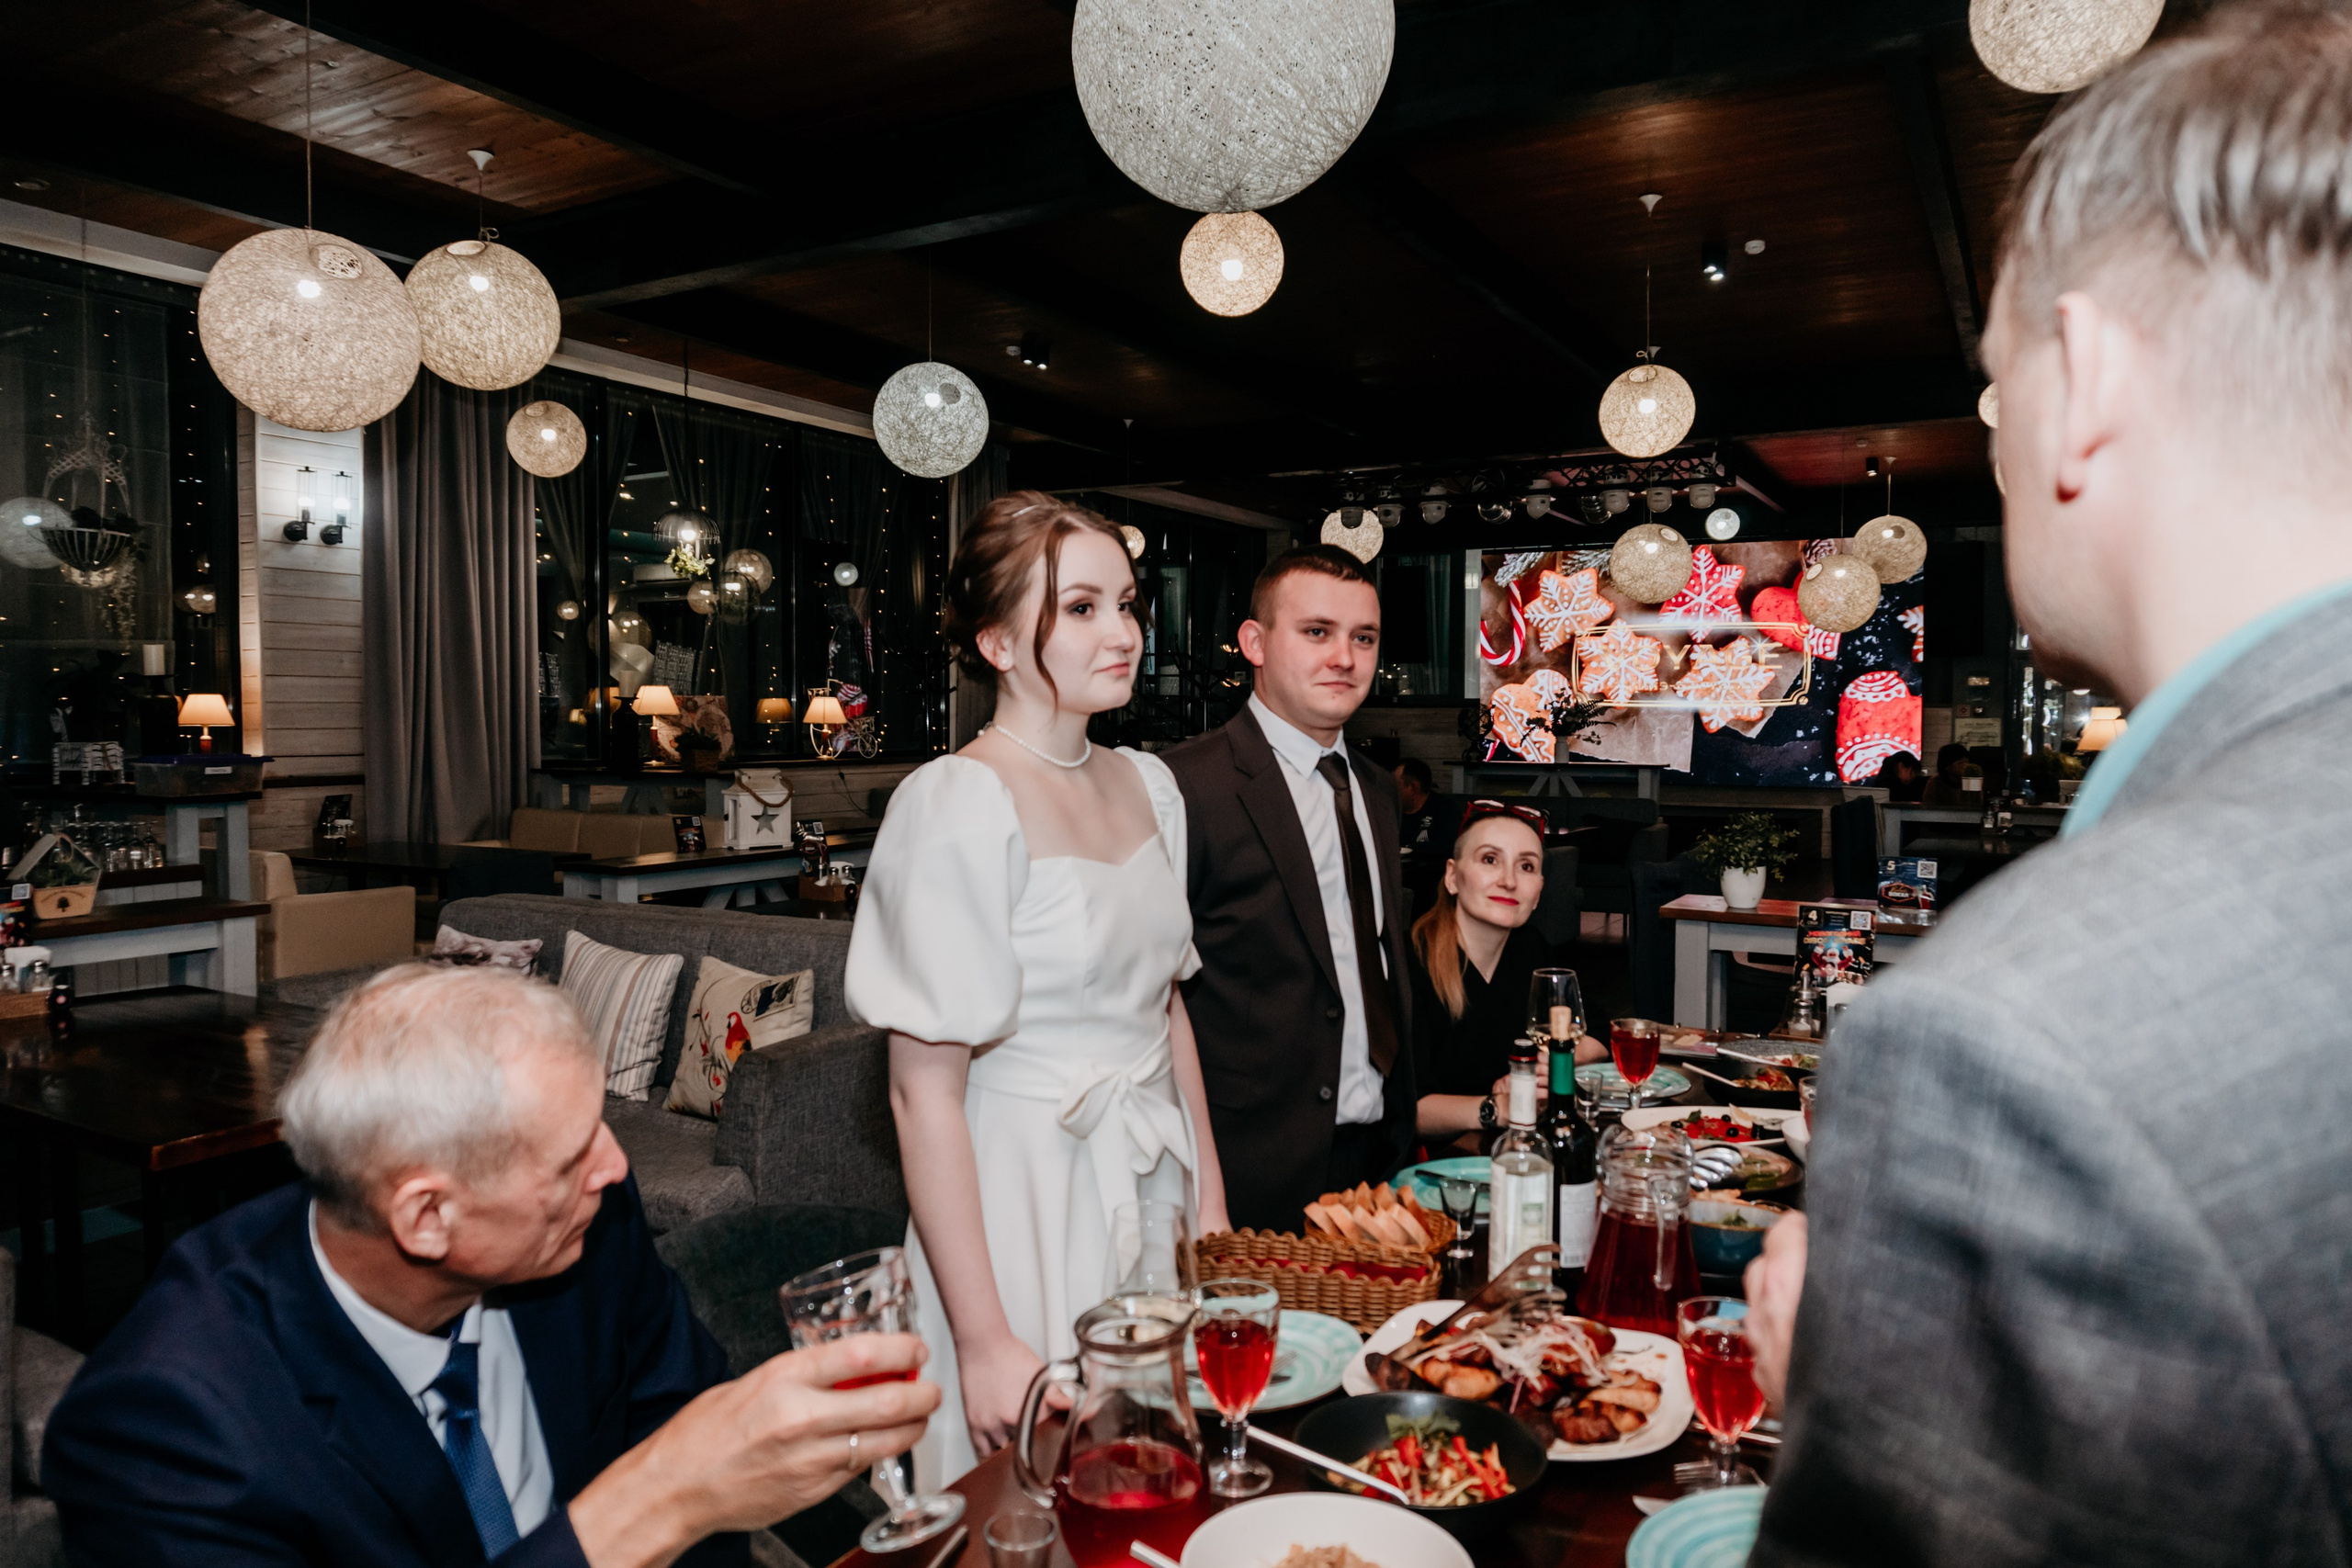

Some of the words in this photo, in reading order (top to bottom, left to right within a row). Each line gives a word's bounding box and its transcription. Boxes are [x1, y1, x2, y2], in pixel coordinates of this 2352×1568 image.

[1598, 642, 1783, 670] VOYAGE
[1887, 861, 1895, 871] 5
[1808, 909, 1818, 921] 4
